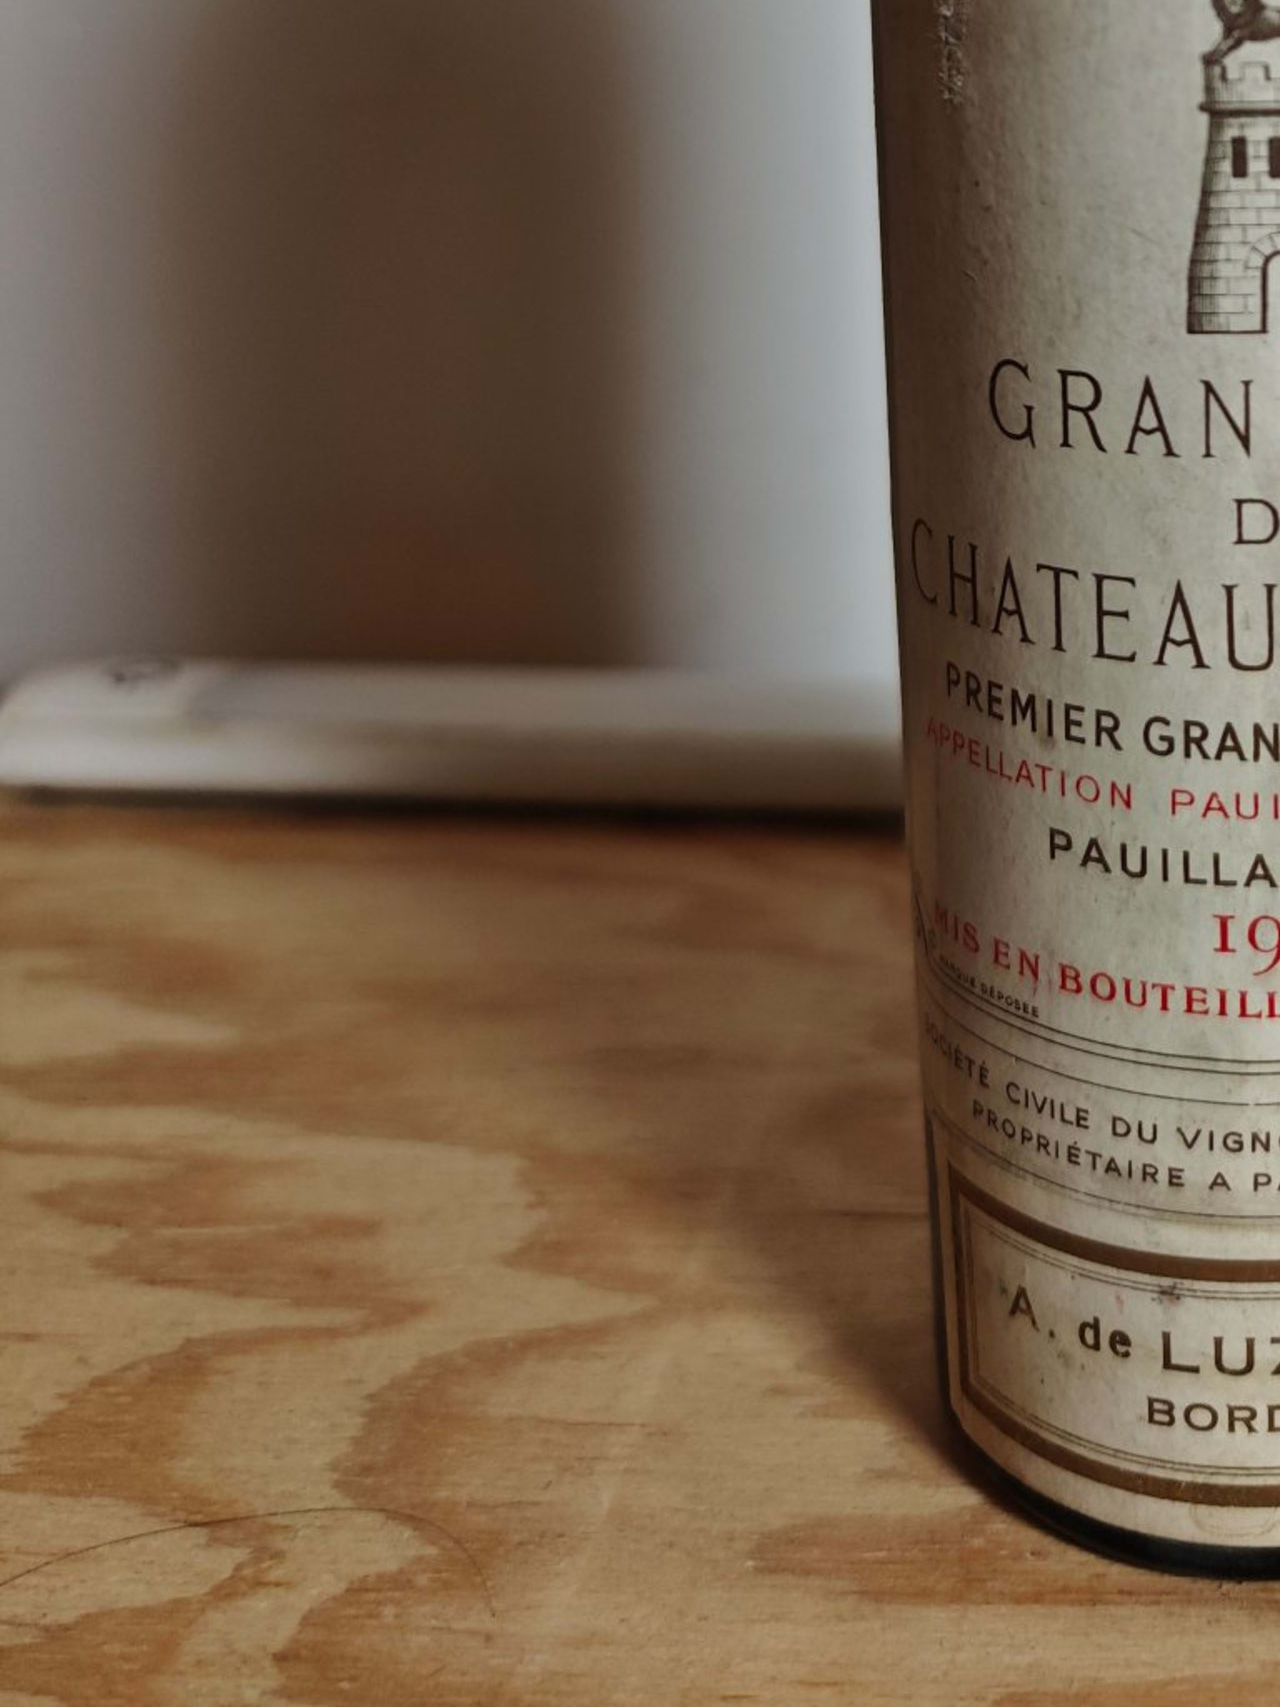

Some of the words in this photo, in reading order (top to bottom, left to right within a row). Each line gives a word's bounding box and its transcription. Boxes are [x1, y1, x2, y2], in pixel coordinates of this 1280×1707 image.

[910, 518, 1278, 671] CHATEAU
[946, 661, 1123, 751] PREMIER
[926, 717, 1132, 811] APPELLATION
[934, 900, 980, 953] MIS
[993, 937, 1040, 982] EN
[972, 1098, 1185, 1188] PROPRIÉTAIRE
[1208, 1171, 1231, 1192] A
[1005, 1081, 1091, 1130] CIVILE
[1112, 1116, 1158, 1144] DU
[1008, 1283, 1055, 1339] A.
[1077, 1315, 1132, 1359] de
